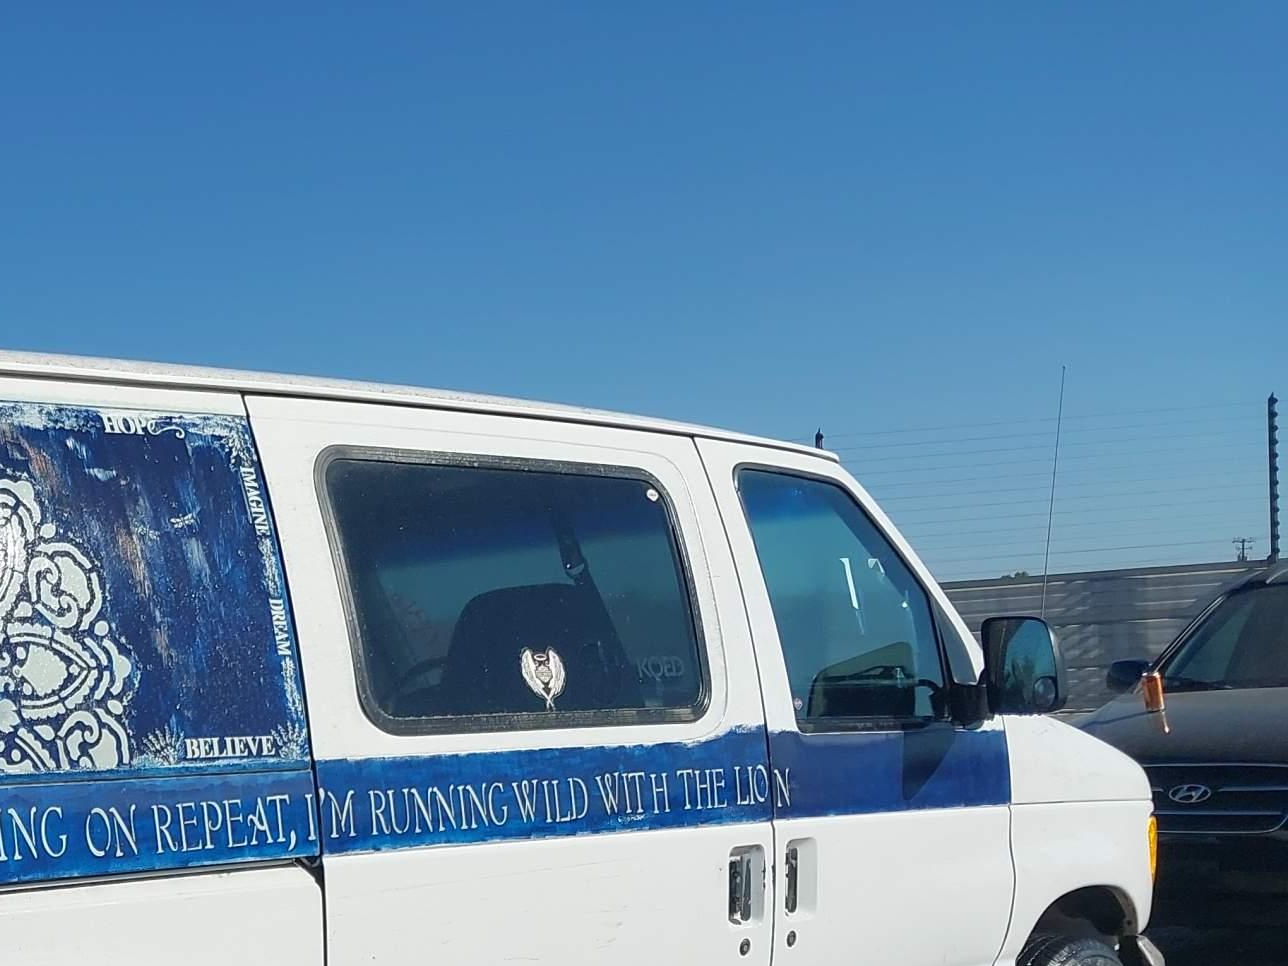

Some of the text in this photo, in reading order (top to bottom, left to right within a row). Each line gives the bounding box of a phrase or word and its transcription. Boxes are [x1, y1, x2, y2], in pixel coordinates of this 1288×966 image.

[240, 465, 272, 536] IMAGINE
[269, 599, 292, 656] DREAM
[184, 735, 276, 759] BELIEVE
[85, 804, 137, 858] ON
[151, 795, 297, 854] REPEAT,
[368, 781, 507, 836] RUNNING
[512, 777, 587, 825] WILD
[596, 771, 670, 816] WITH
[676, 767, 727, 812] THE
[733, 763, 791, 808] LION
